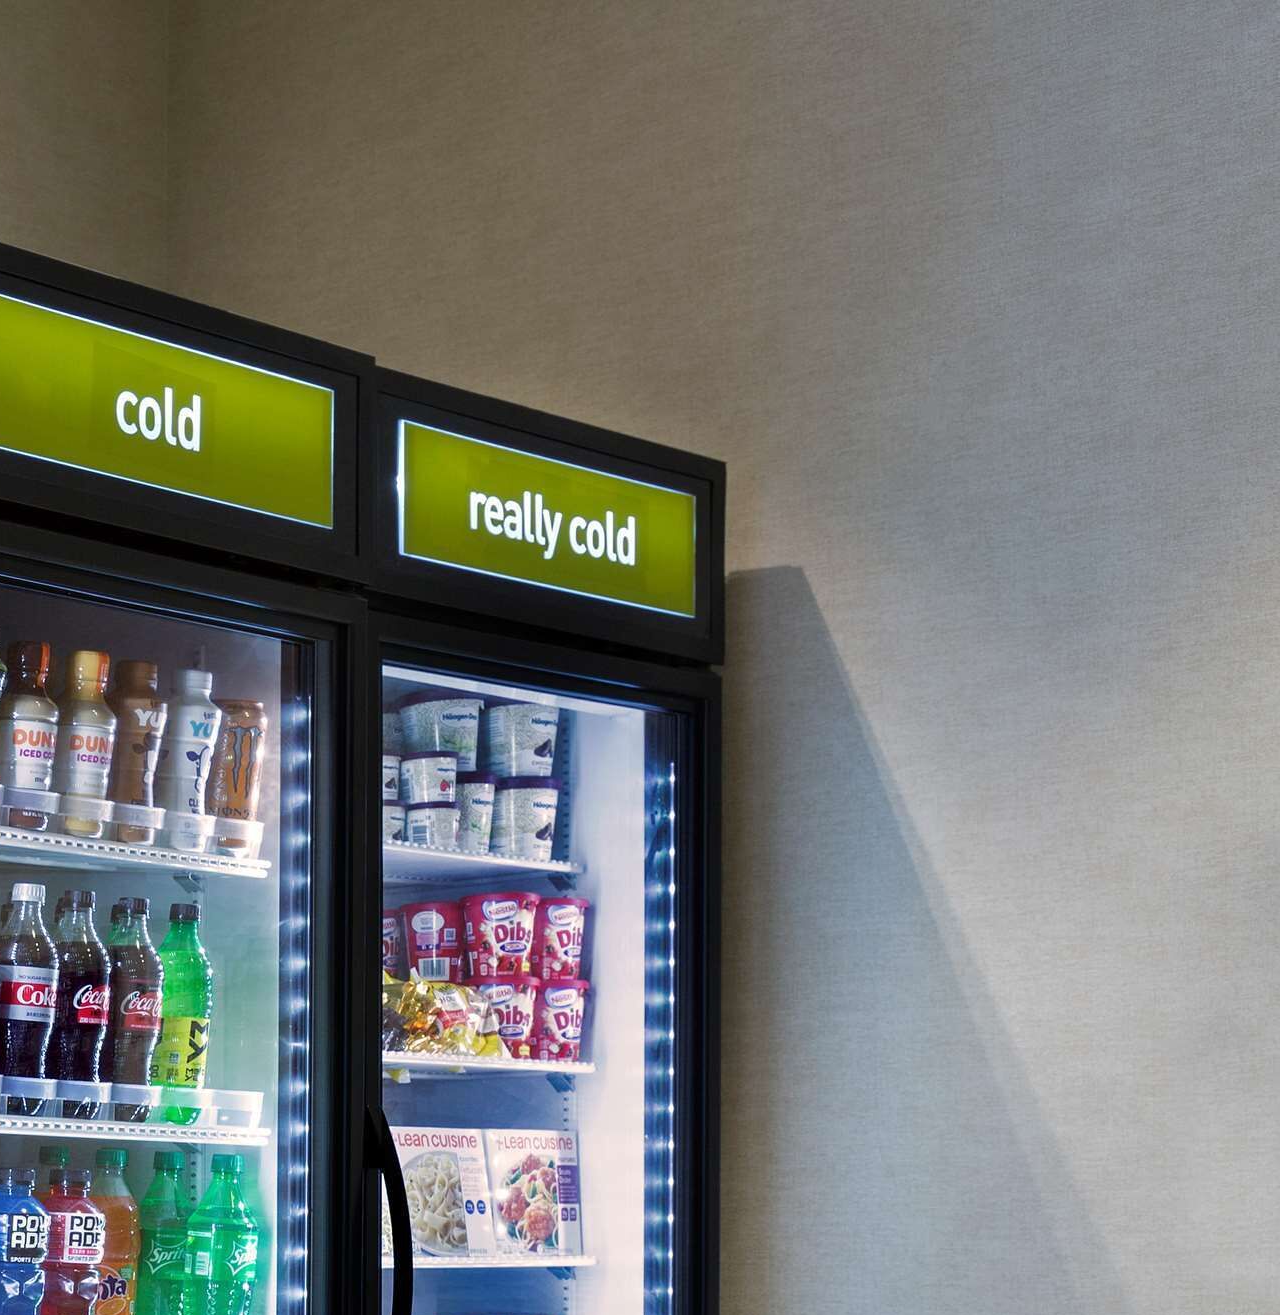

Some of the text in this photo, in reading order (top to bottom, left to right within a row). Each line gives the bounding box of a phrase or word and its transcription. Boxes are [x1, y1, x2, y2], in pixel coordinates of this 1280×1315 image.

[115, 386, 202, 453] cold
[468, 490, 637, 567] really cold
[12, 728, 57, 750] DUN
[69, 735, 112, 754] DUN
[19, 749, 42, 759] ICED
[76, 753, 99, 763] ICED
[494, 920, 532, 944] Dibs
[556, 926, 583, 949] Dib
[16, 983, 57, 1008] Coke
[553, 1007, 583, 1031] Dib
